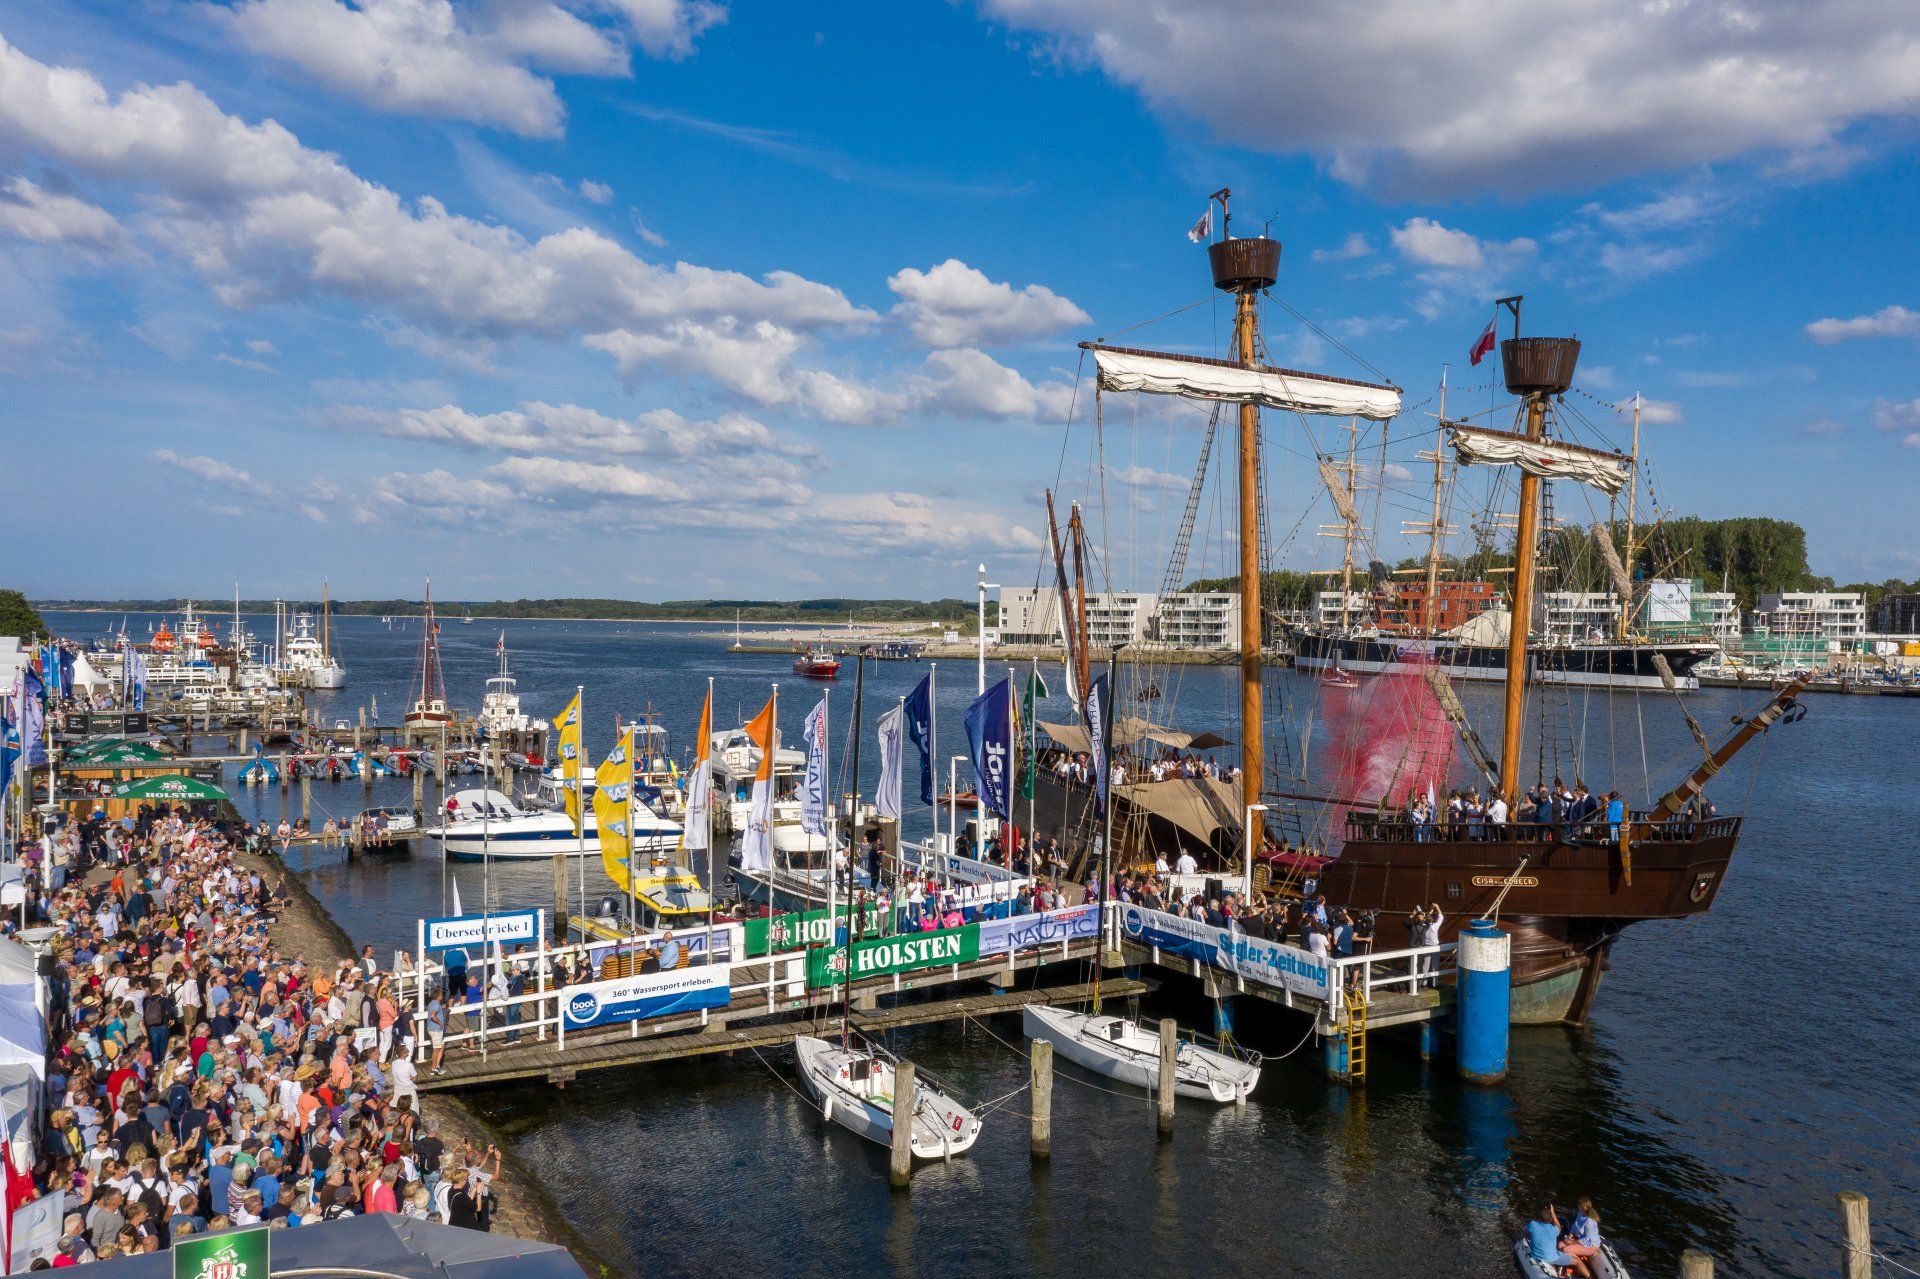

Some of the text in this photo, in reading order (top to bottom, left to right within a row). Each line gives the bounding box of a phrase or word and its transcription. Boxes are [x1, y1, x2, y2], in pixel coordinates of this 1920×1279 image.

[650, 877, 683, 885] SeaHelp
[523, 921, 529, 931] 1
[1007, 912, 1093, 947] NAUTIC
[857, 934, 961, 972] HOLSTEN
[1219, 933, 1327, 988] Segler-Zeitung
[612, 977, 714, 998] 360° Wassersport erleben.
[572, 999, 595, 1010] boot
